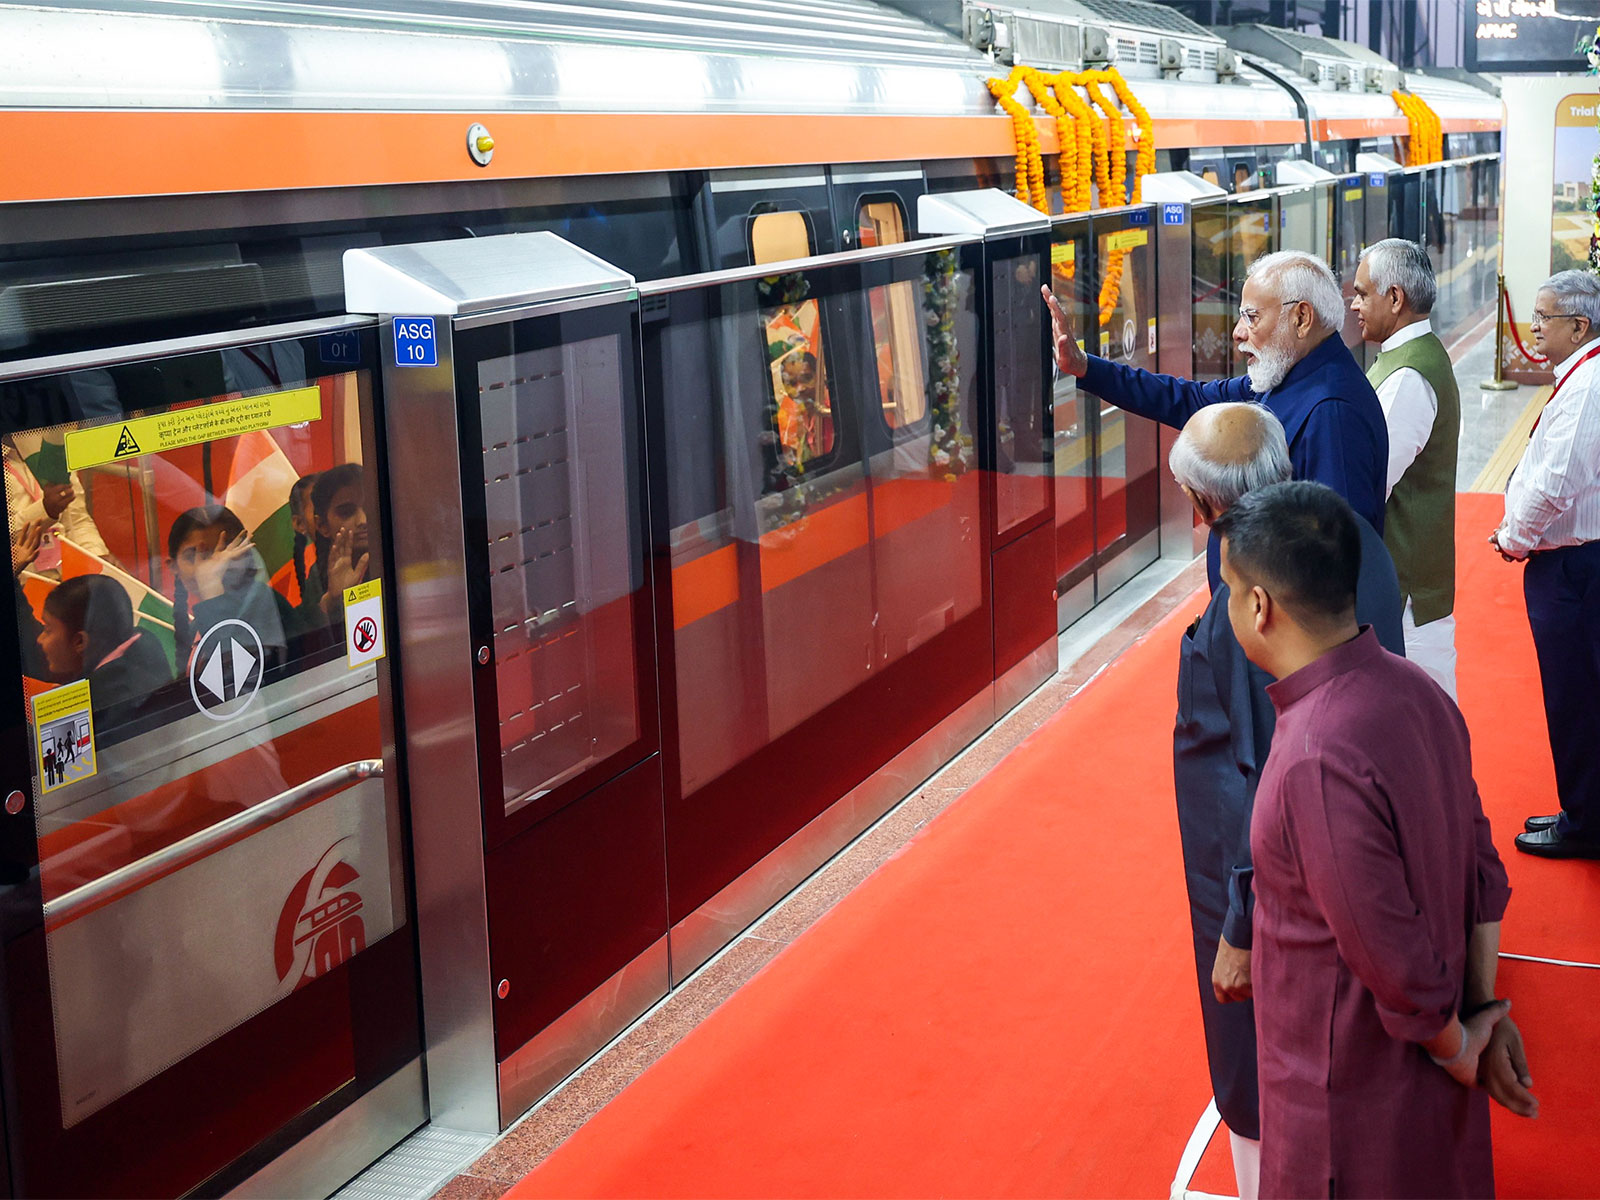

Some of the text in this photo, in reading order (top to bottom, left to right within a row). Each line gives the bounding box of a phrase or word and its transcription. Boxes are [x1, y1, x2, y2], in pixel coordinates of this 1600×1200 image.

[1476, 23, 1518, 39] APMC
[1570, 106, 1594, 116] Trial
[1166, 206, 1182, 214] ASG
[398, 324, 432, 339] ASG
[407, 344, 425, 361] 10
